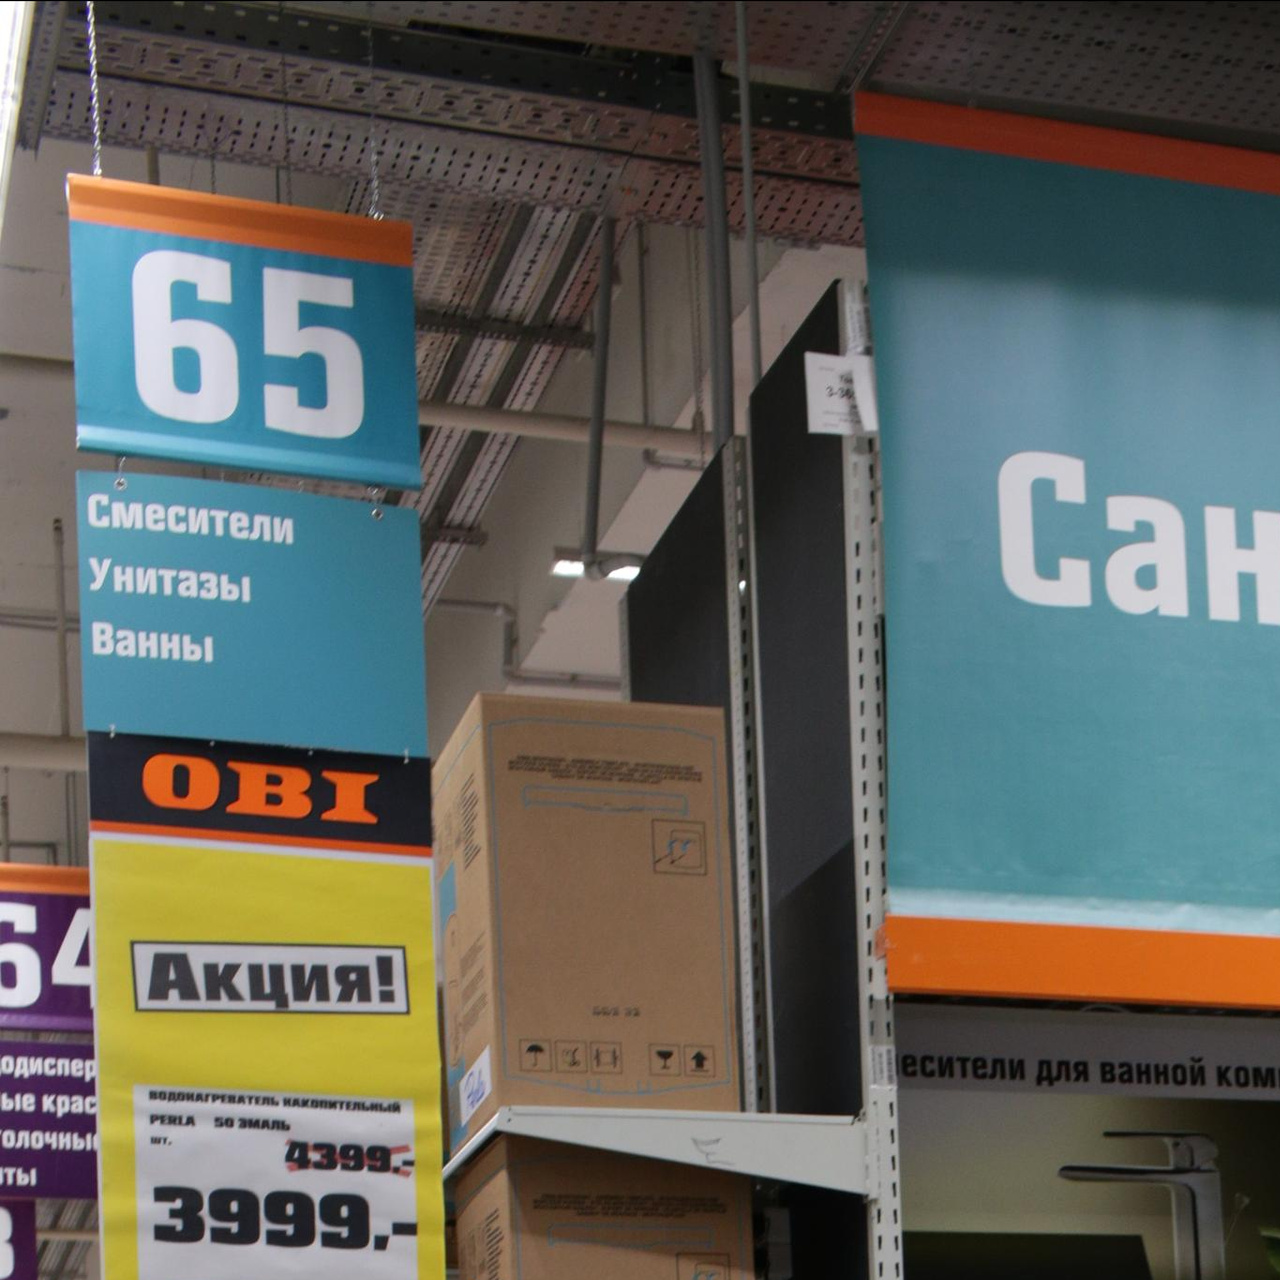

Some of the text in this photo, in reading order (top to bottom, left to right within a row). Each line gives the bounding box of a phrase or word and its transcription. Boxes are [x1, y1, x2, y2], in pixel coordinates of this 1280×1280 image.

[132, 249, 365, 439] 65
[87, 493, 294, 545] Смесители
[89, 557, 251, 603] Унитазы
[92, 621, 213, 663] Ванны
[142, 753, 379, 825] OBI
[148, 952, 395, 1009] Акция!
[1037, 1059, 1089, 1086] для
[1100, 1058, 1205, 1087] ванной
[149, 1090, 400, 1113] ВОДОНАГРЕВАТЕЛЬ НАКОПИТЕЛЬНЫЙ
[150, 1114, 195, 1127] PERLA
[214, 1117, 234, 1128] 50
